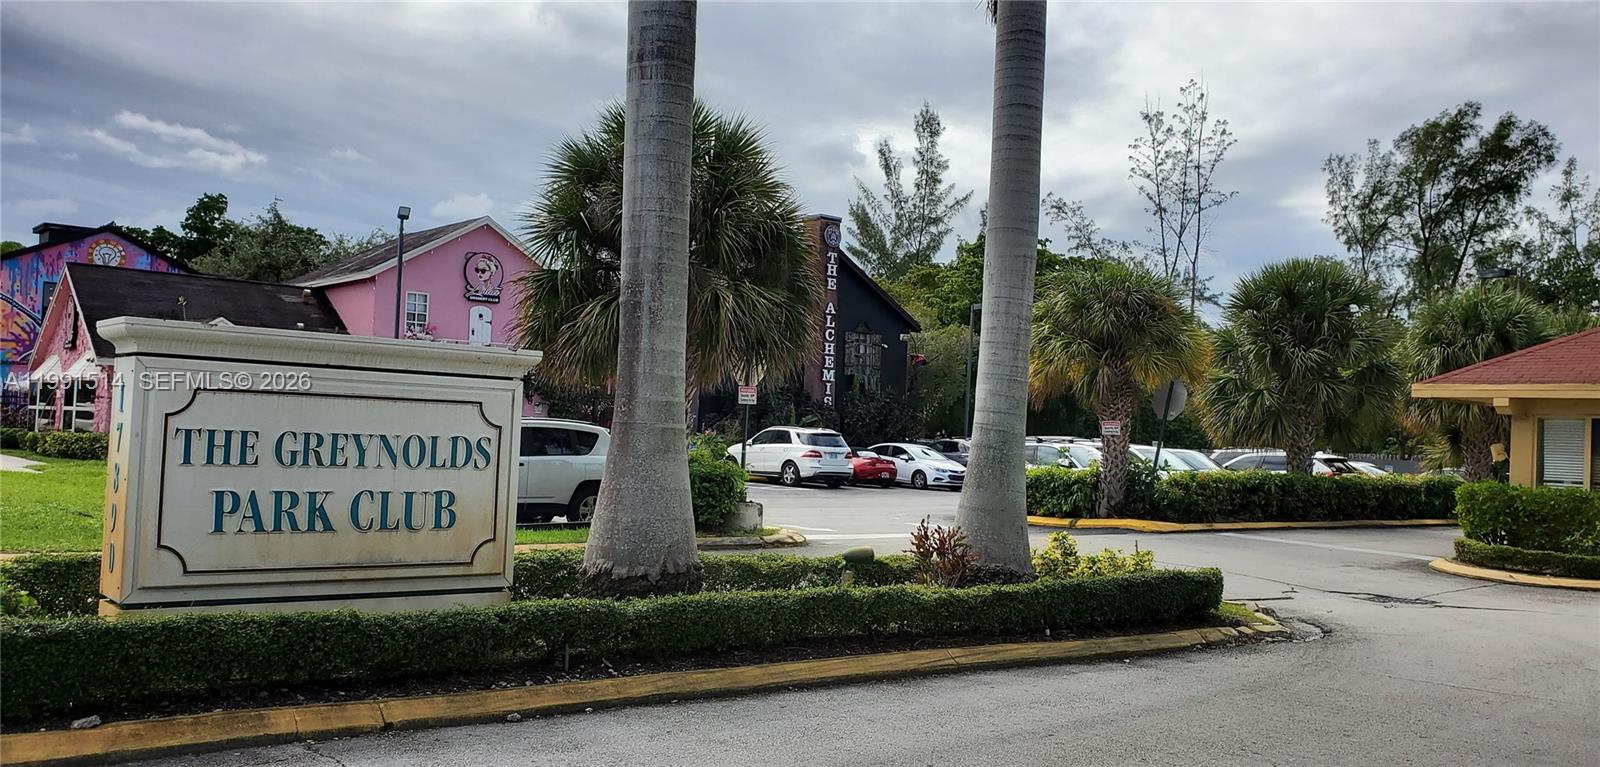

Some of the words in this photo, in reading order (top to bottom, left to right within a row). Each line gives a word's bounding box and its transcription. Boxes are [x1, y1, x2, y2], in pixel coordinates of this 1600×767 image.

[826, 252, 838, 290] THE
[822, 302, 837, 406] ALCHEMIS
[173, 426, 260, 467] THE
[273, 430, 492, 470] GREYNOLDS
[208, 489, 337, 535] PARK
[349, 488, 458, 534] CLUB
